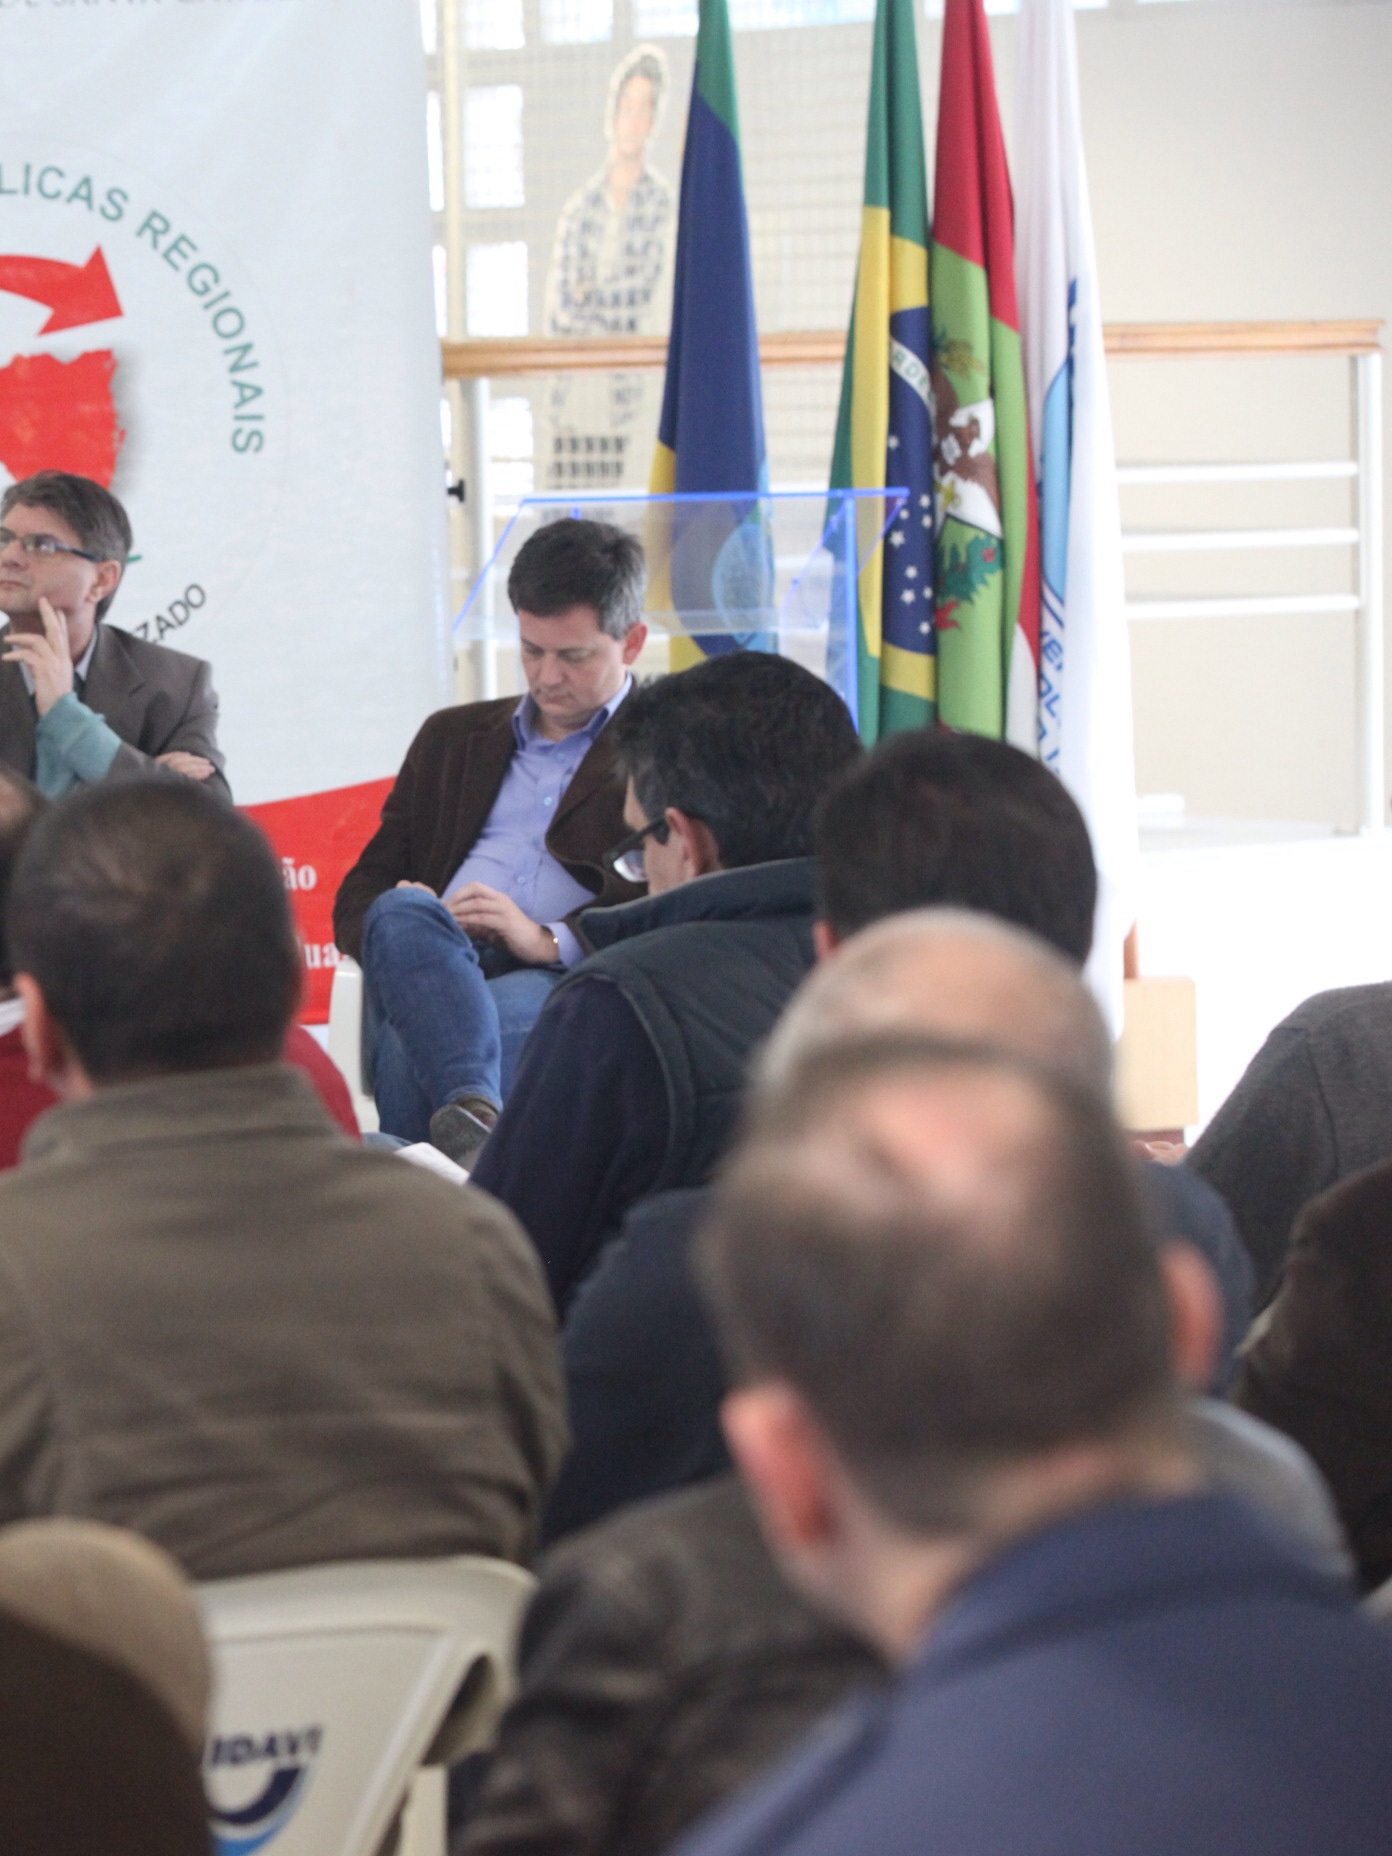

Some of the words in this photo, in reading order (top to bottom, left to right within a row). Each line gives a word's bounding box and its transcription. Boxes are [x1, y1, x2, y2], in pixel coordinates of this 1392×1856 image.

[136, 209, 266, 455] REGIONAIS
[134, 583, 206, 645] ZADO
[281, 856, 318, 892] ão
[210, 1724, 325, 1769] IDAVI
